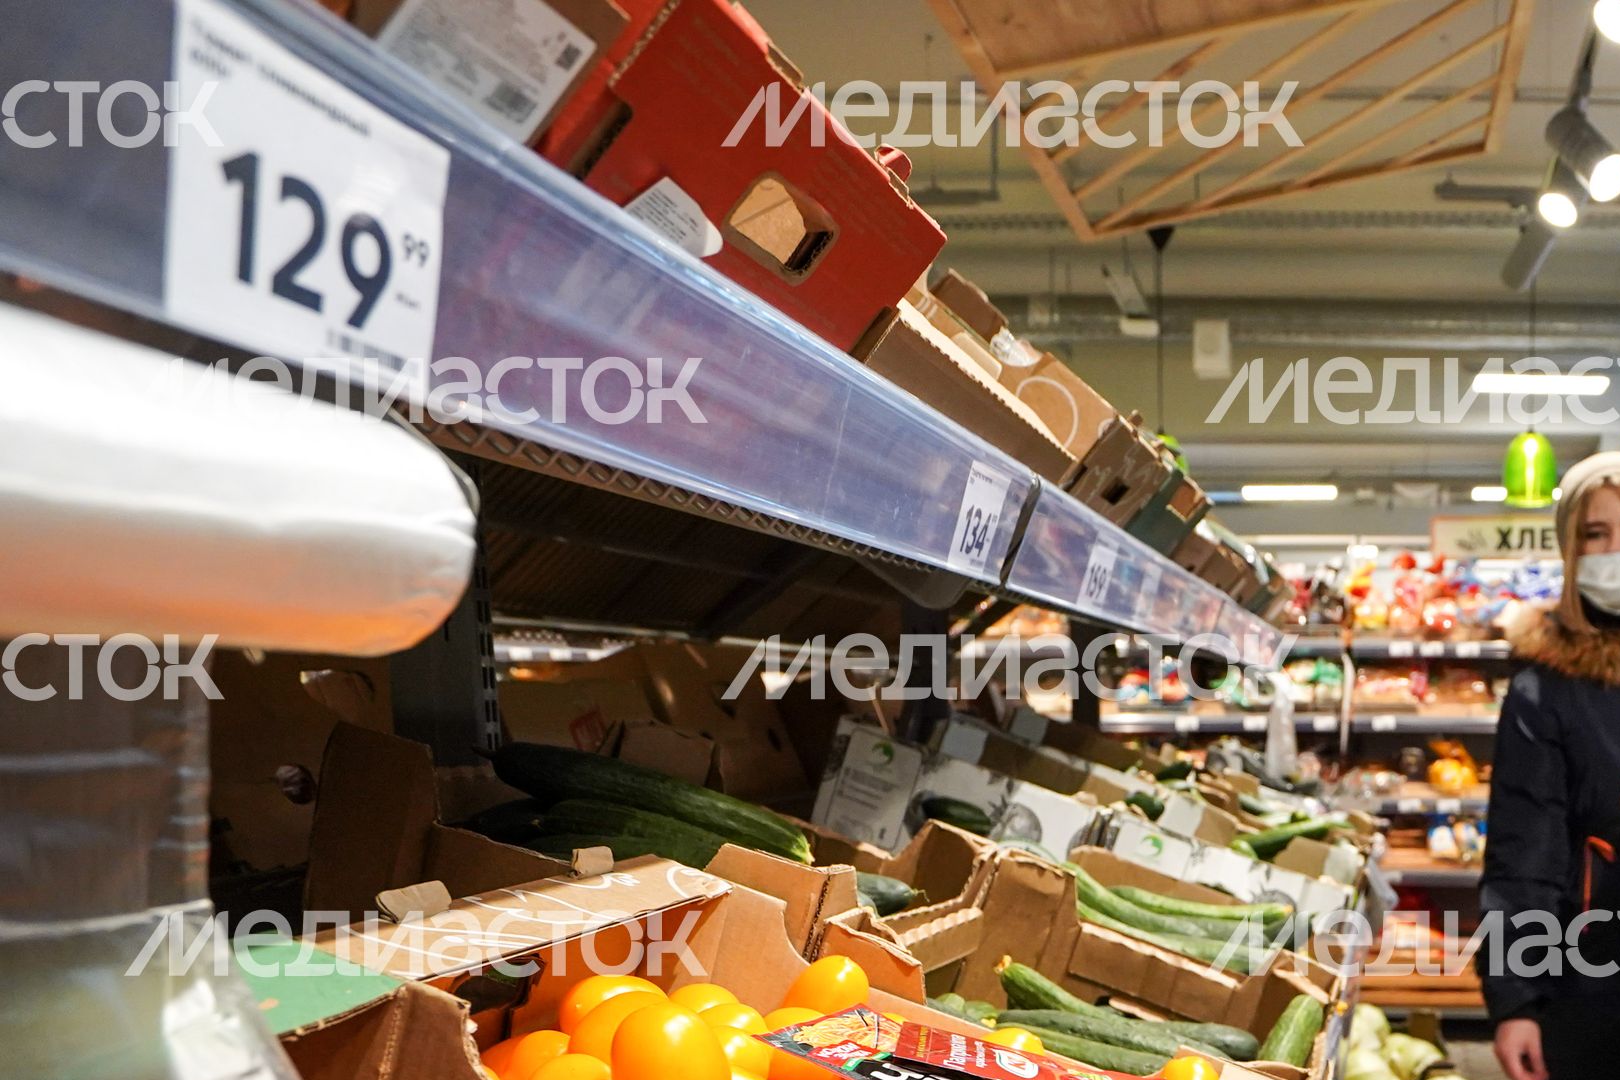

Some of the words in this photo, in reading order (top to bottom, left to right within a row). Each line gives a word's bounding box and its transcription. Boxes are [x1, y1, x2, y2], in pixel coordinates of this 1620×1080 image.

[221, 152, 393, 330] 129
[402, 233, 430, 267] 99
[959, 504, 992, 558] 134
[1496, 526, 1557, 551] ХЛЕ
